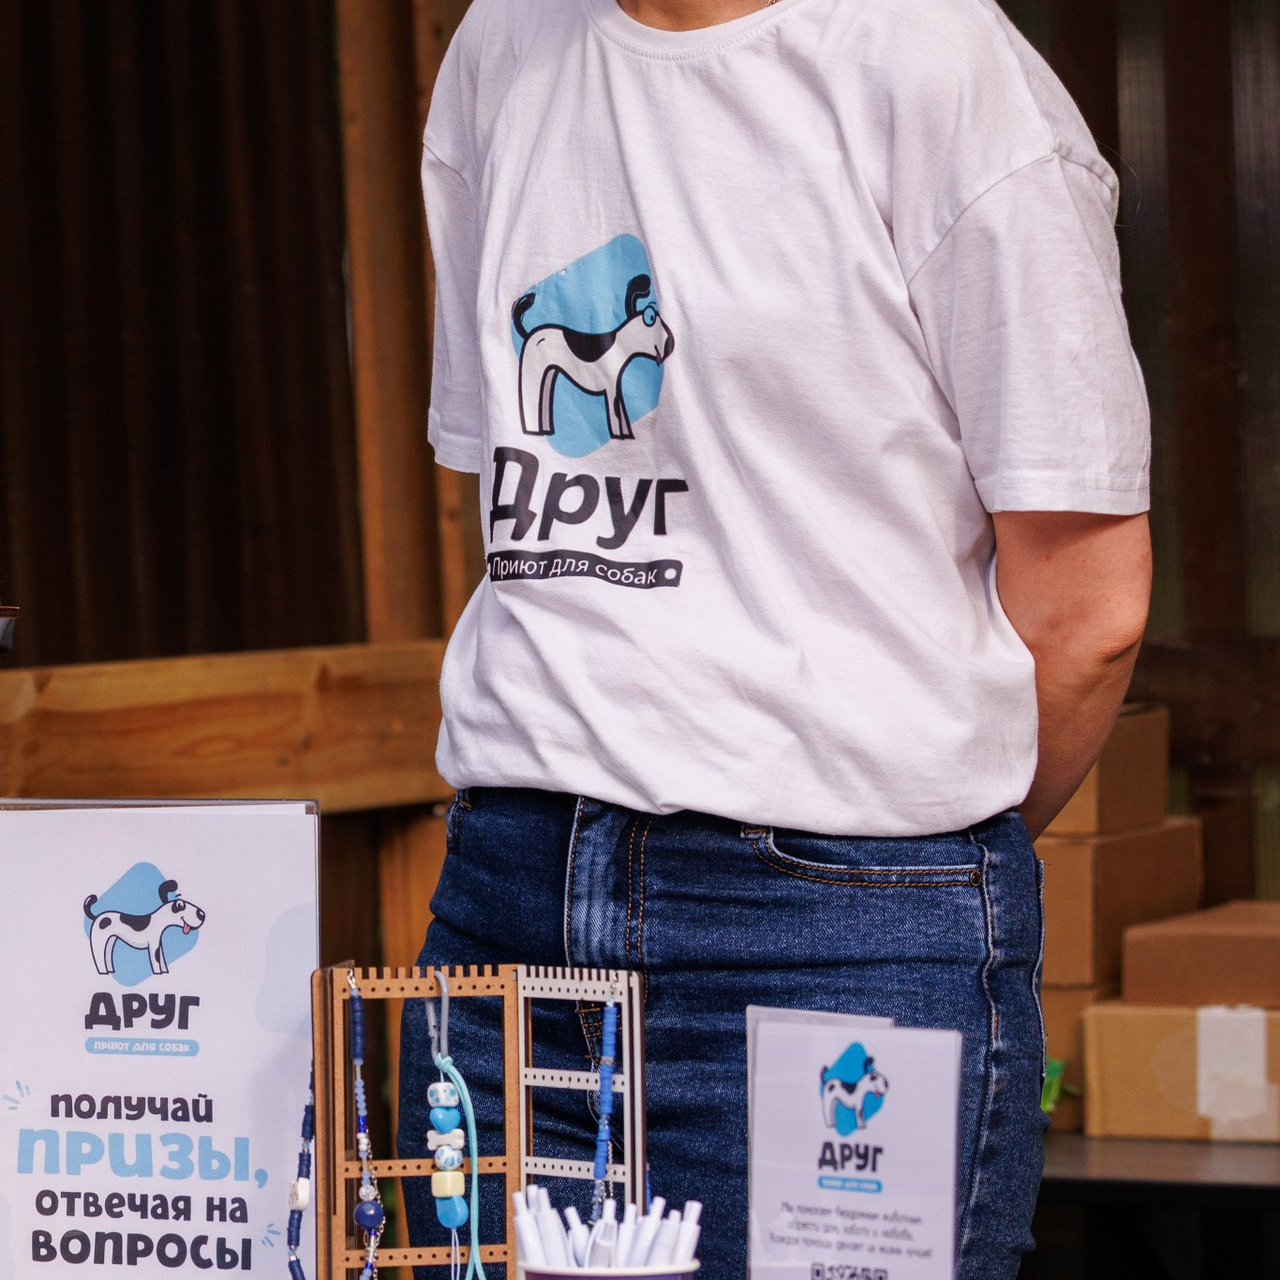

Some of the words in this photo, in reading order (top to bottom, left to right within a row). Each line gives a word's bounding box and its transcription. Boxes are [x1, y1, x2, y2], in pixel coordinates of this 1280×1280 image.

[490, 446, 689, 550] Друг
[492, 557, 545, 579] Приют
[548, 558, 589, 578] для
[595, 564, 658, 585] собак
[50, 1093, 214, 1123] получай
[35, 1189, 192, 1221] отвечая
[206, 1196, 249, 1224] на
